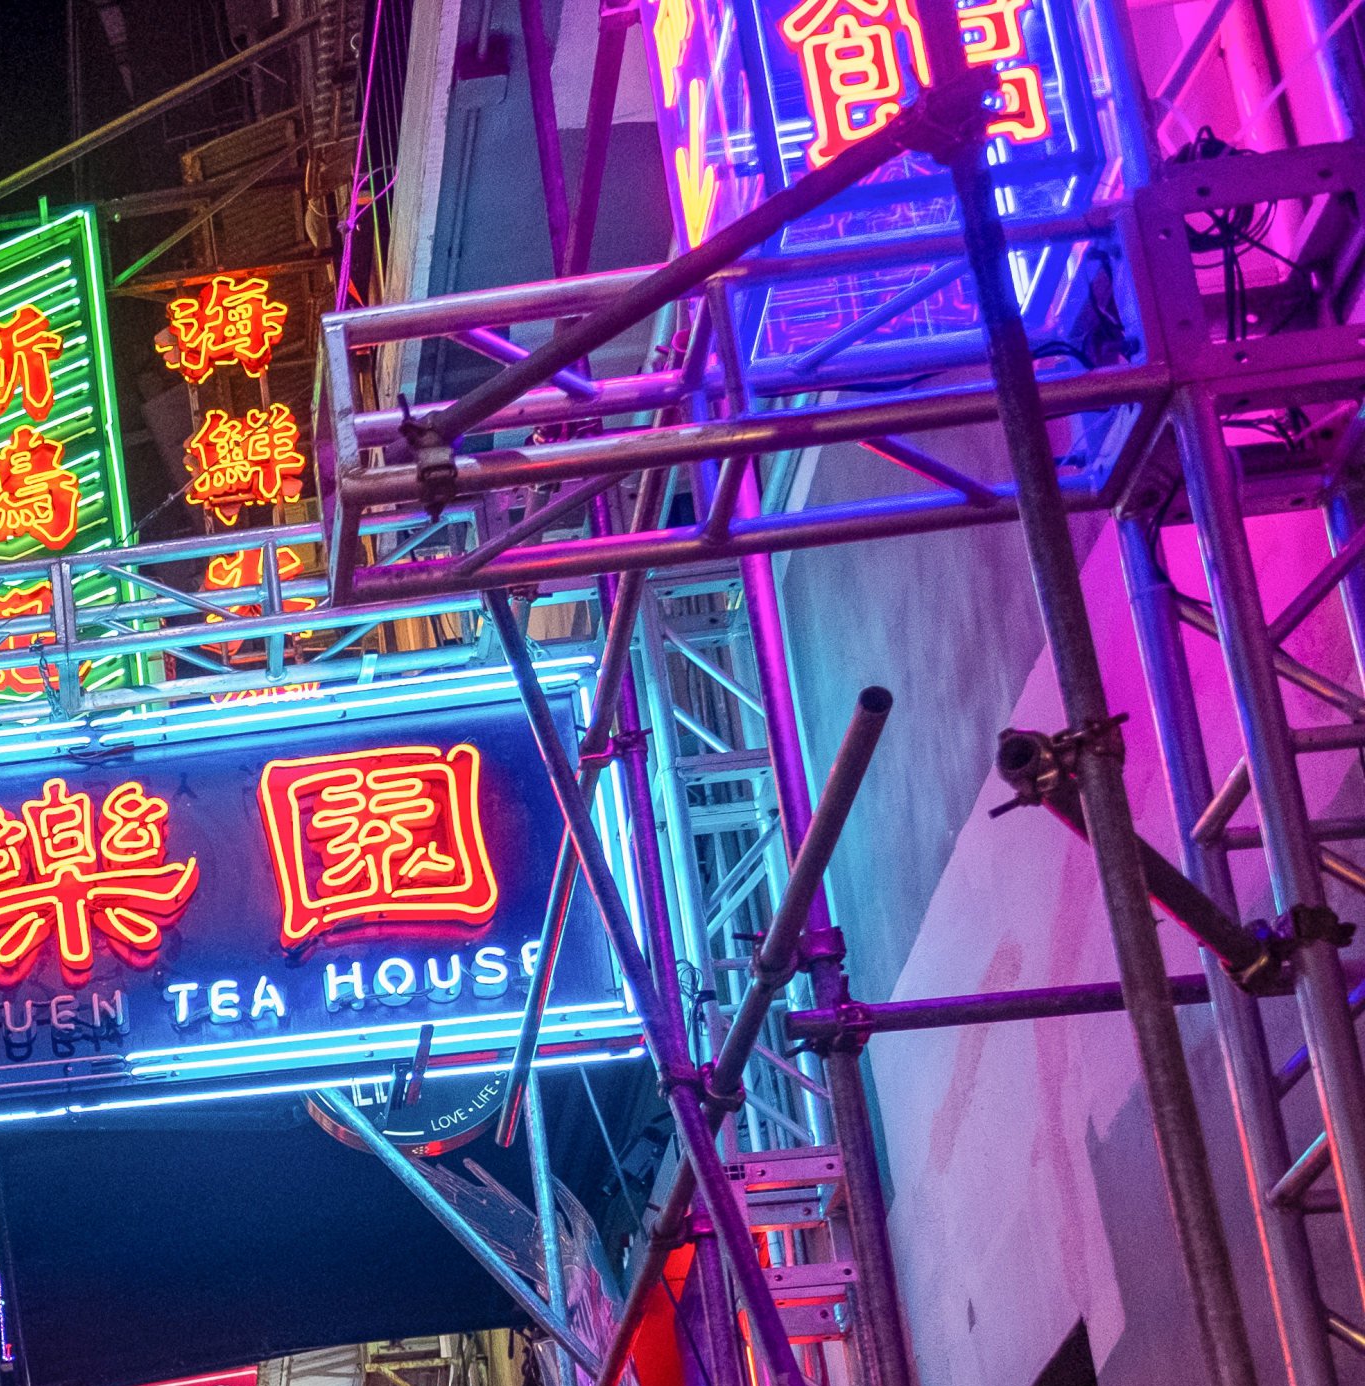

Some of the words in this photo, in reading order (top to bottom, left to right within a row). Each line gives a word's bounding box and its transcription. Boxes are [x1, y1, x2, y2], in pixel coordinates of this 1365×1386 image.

[165, 974, 287, 1024] TEA
[325, 940, 543, 1004] HOUSE
[430, 1108, 469, 1132] LOVE
[471, 1083, 499, 1111] LIFE
